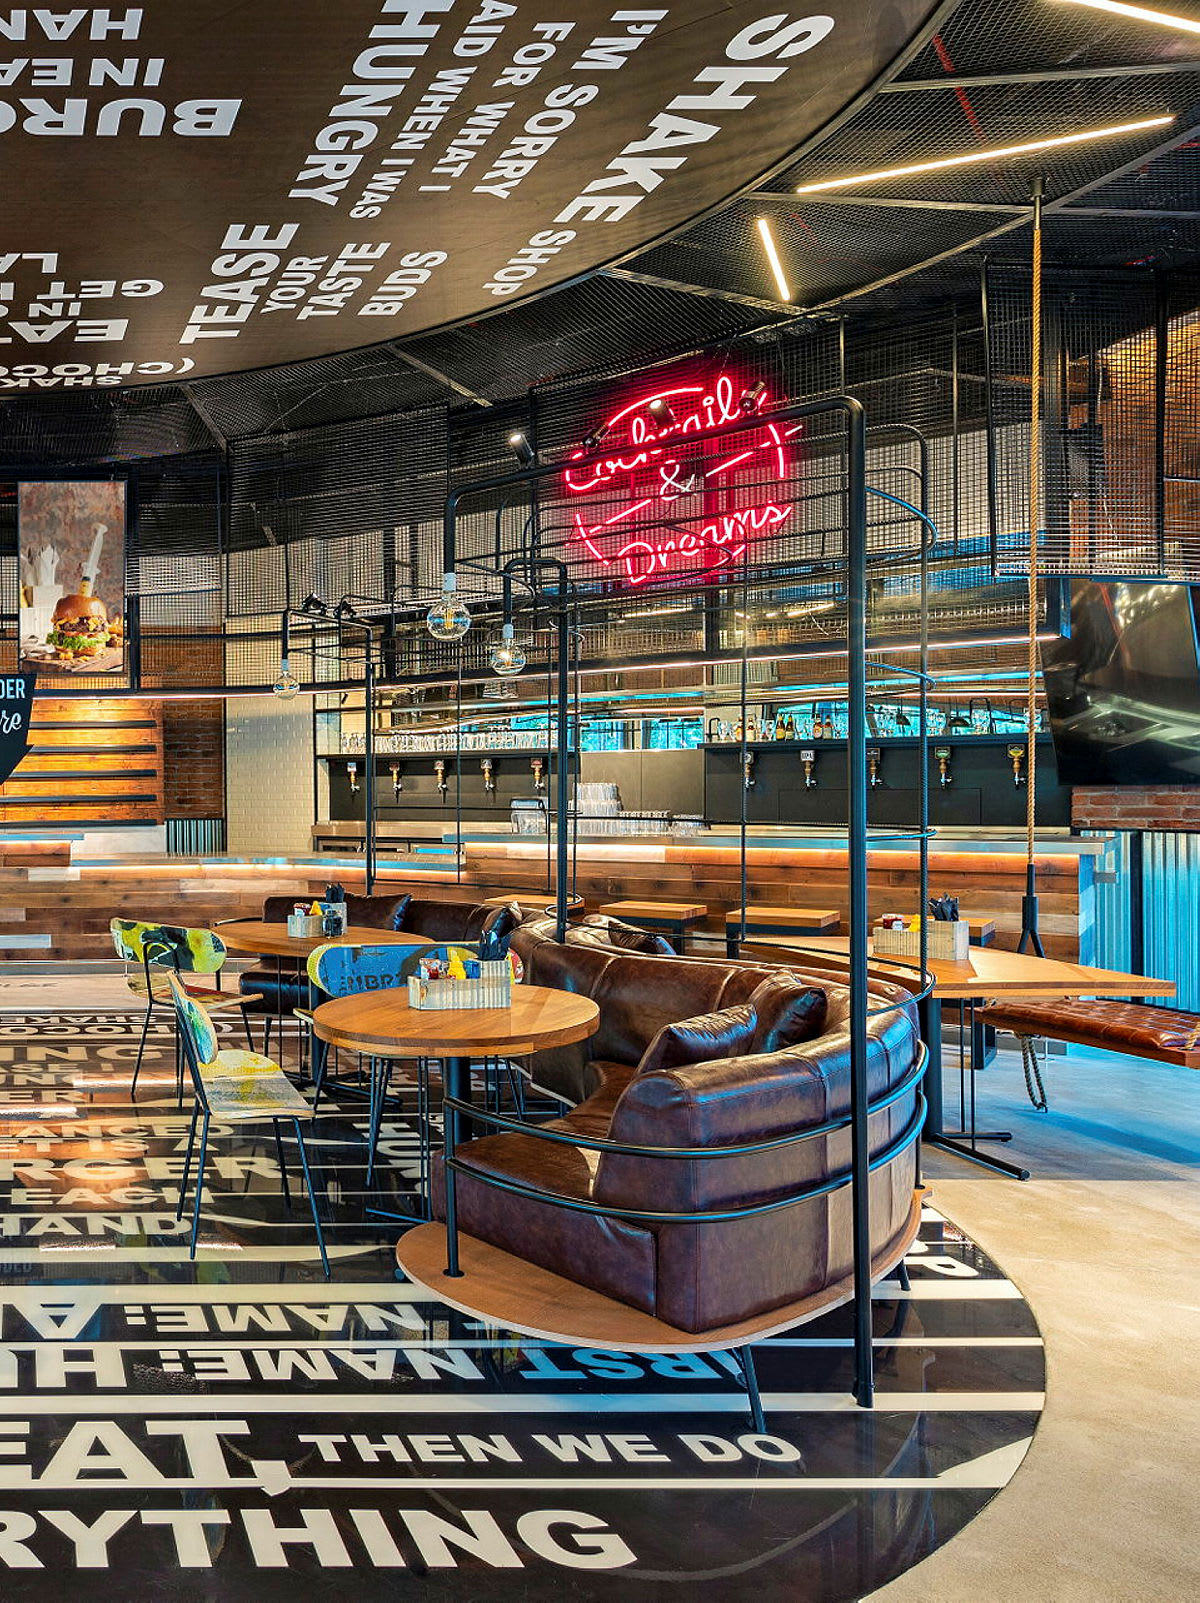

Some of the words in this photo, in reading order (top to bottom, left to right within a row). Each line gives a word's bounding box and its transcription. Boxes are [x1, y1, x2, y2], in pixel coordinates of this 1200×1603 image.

[491, 22, 577, 88] FOR
[570, 9, 670, 70] I'M
[88, 58, 165, 87] IN
[288, 0, 455, 207] HUNGRY
[390, 65, 478, 150] WHEN
[552, 13, 835, 223] SHAKE
[380, 158, 416, 166] I
[431, 101, 516, 178] WHAT
[471, 83, 599, 200] SORRY
[349, 170, 407, 219] WAS
[36, 279, 165, 300] GET
[178, 223, 300, 345] TEASE
[259, 255, 329, 314] YOUR
[296, 242, 392, 321] TASTE
[357, 250, 448, 316] BUDS
[482, 229, 577, 296] SHOP
[28, 301, 82, 318] IN
[659, 459, 698, 501] &
[618, 500, 792, 584] Dreams
[0, 1015, 157, 1025] SHAKE
[88, 1137, 150, 1154] IS
[172, 1137, 220, 1152] A
[10, 1186, 216, 1206] EACH
[125, 1303, 436, 1334] NAME:
[161, 1346, 484, 1380] NAME:
[519, 1347, 742, 1381] IRST
[298, 1434, 523, 1463] THEN
[533, 1433, 671, 1463] WE
[685, 1433, 802, 1464] DO
